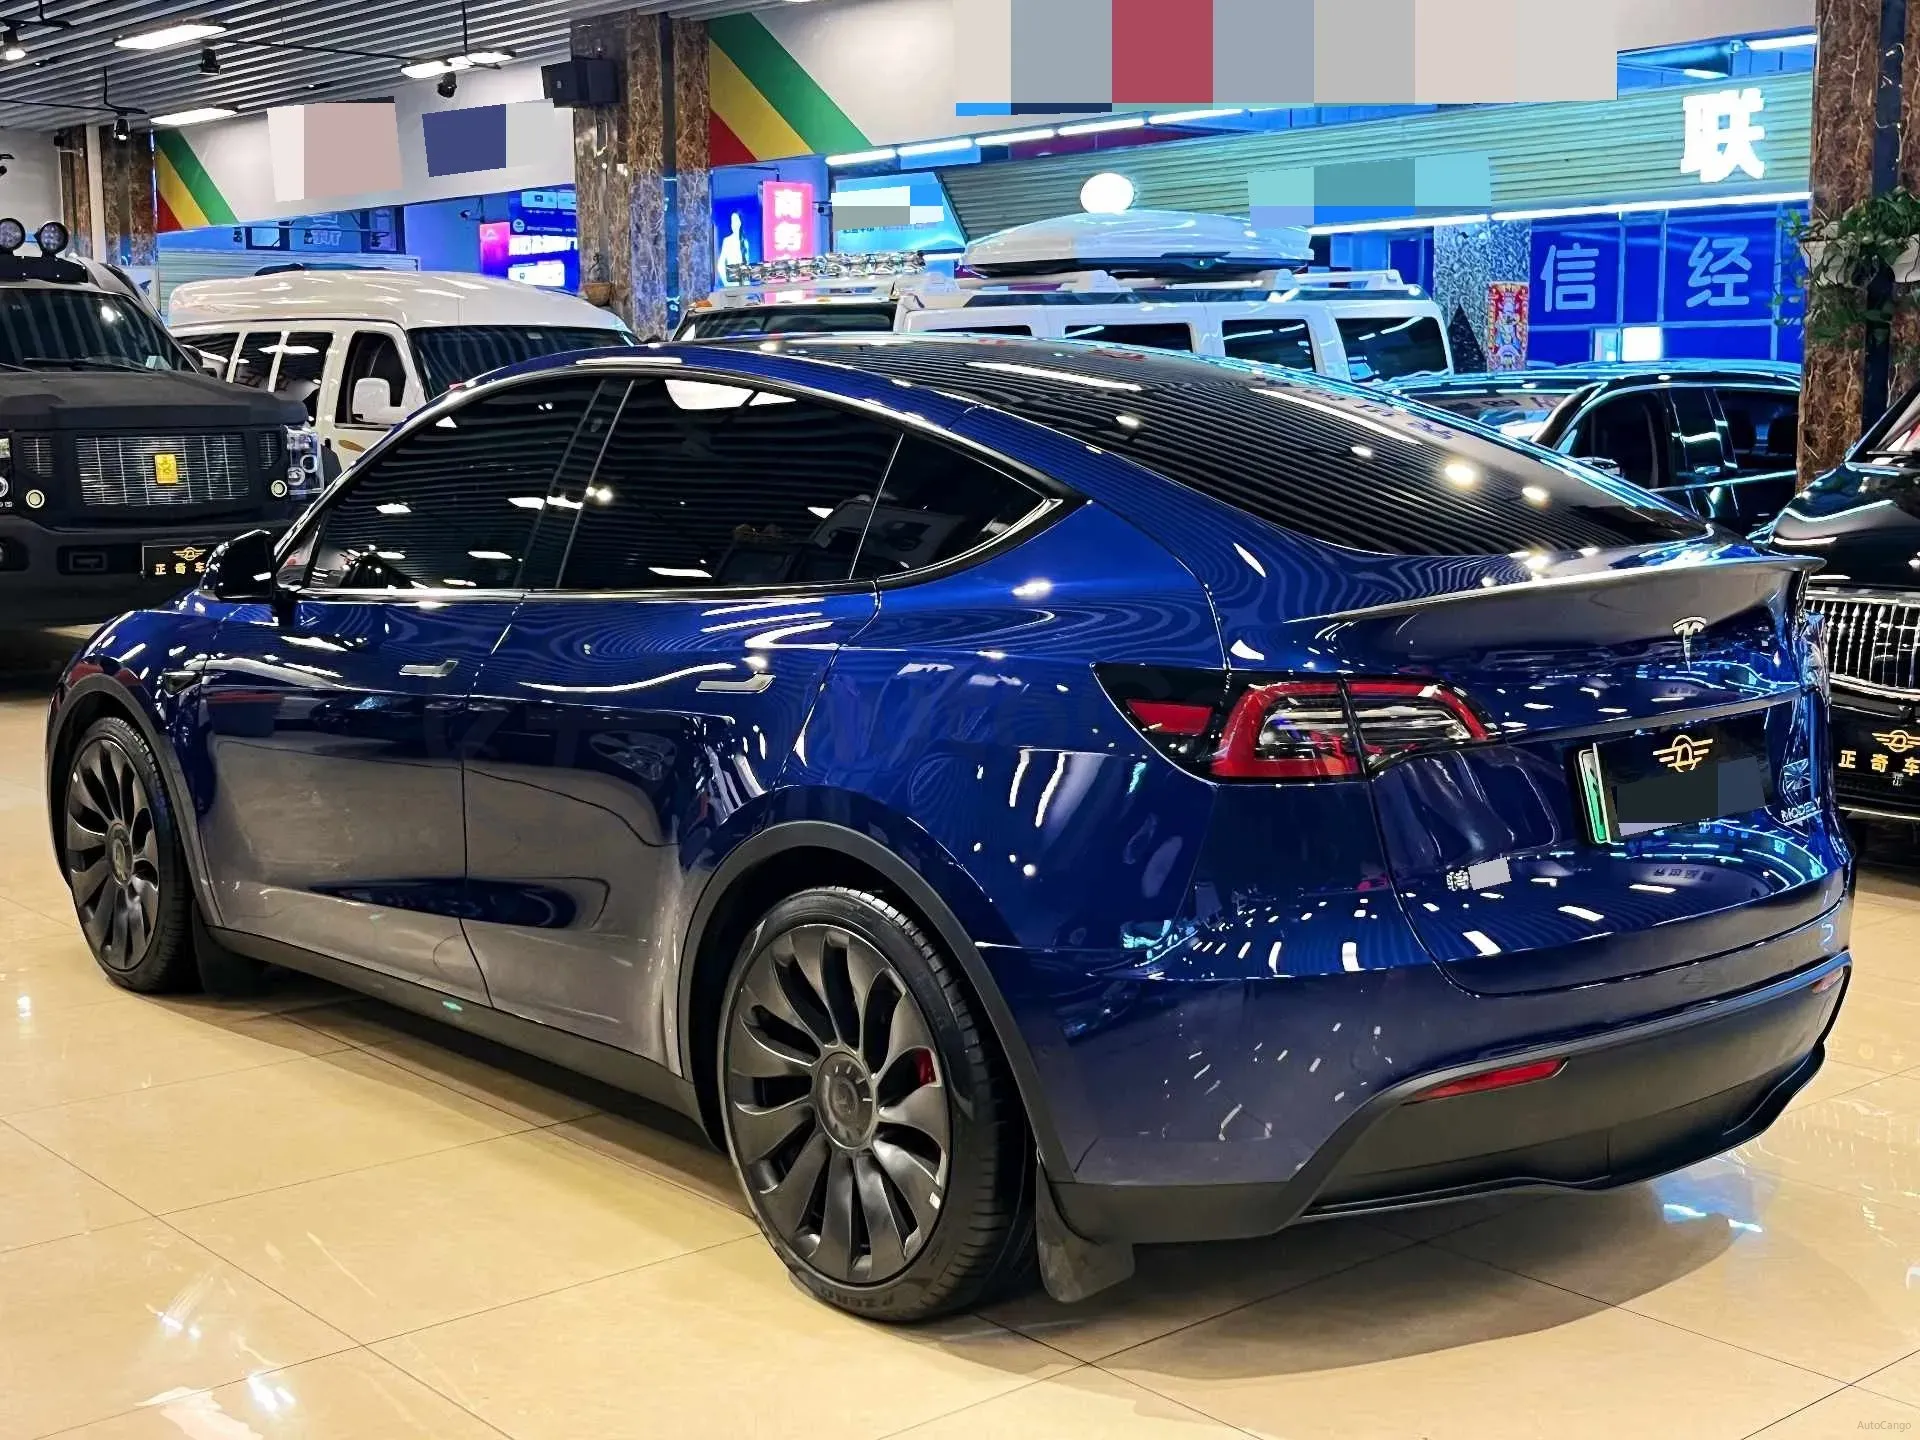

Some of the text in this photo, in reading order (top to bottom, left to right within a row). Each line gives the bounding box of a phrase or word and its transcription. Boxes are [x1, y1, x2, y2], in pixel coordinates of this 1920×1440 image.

[1680, 87, 1765, 183] 联
[775, 188, 802, 260] 商务
[1540, 237, 1752, 313] 信 经
[1838, 749, 1920, 776] 正奇车
